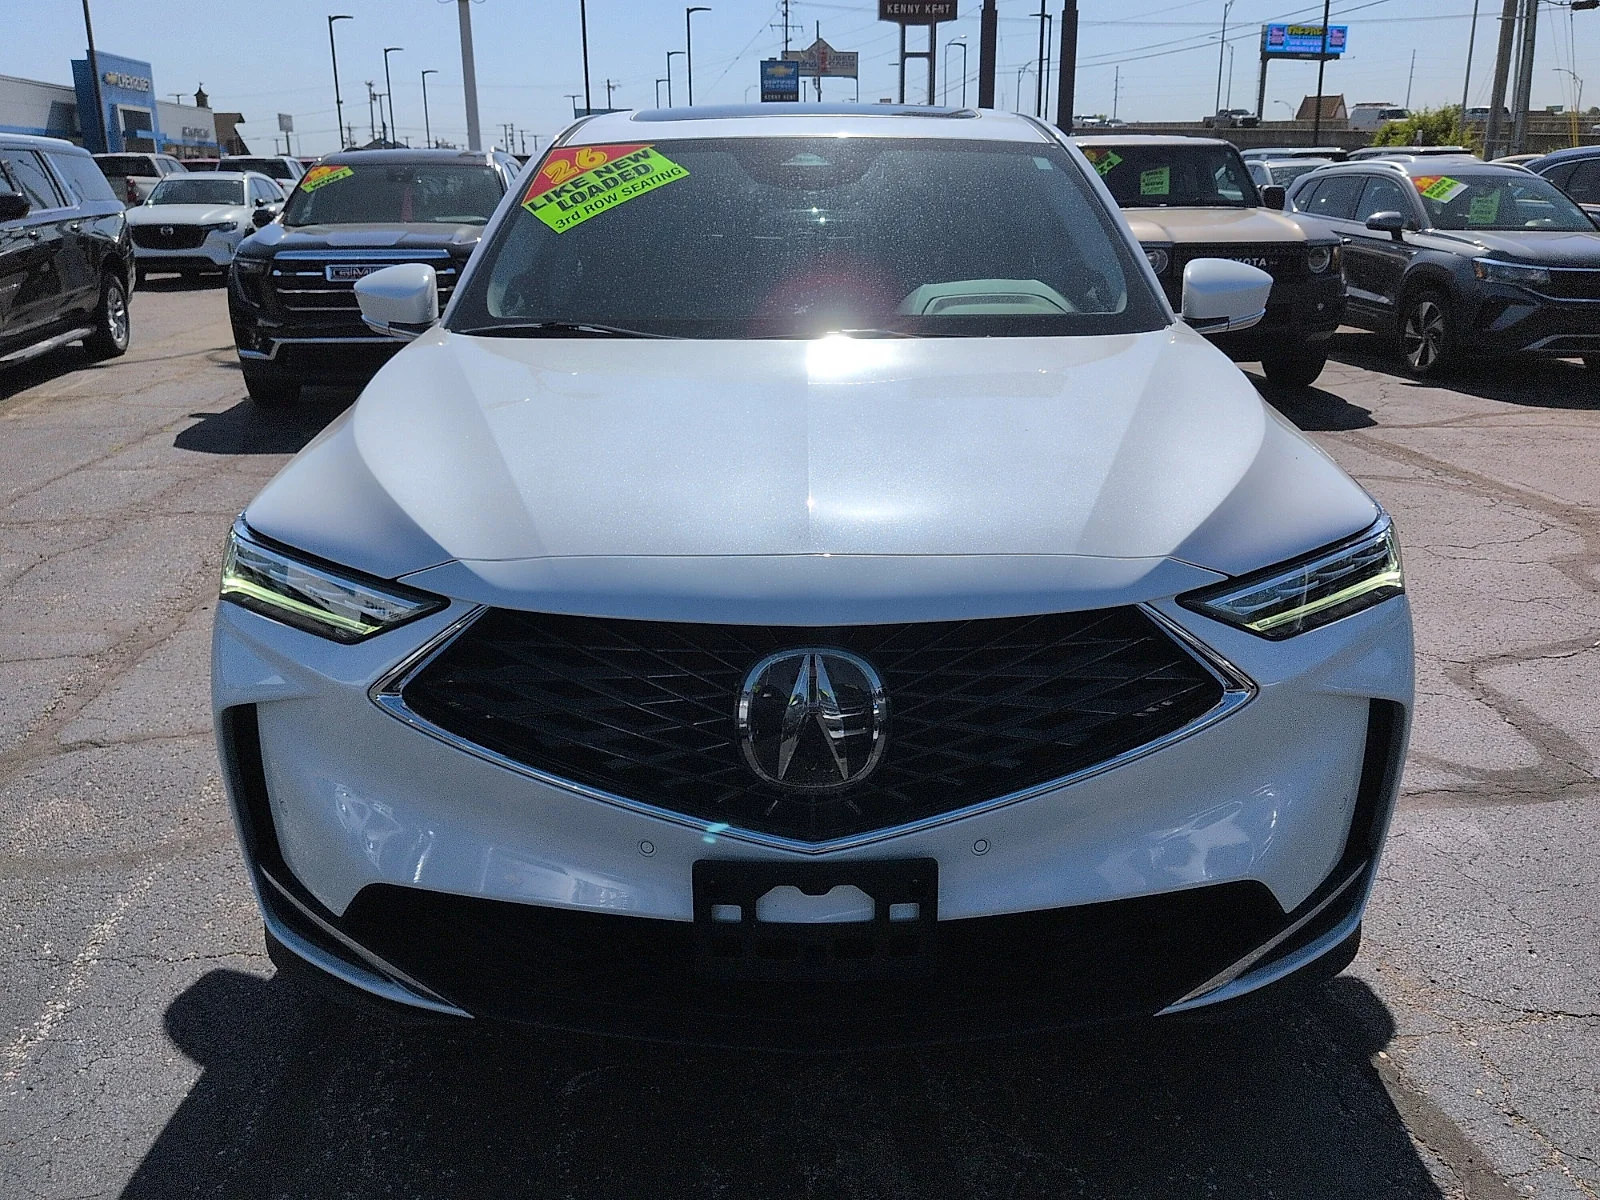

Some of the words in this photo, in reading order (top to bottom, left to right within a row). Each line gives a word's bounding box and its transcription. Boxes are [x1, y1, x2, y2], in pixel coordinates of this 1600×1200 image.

[887, 4, 920, 14] KENNY
[925, 4, 950, 14] KENT
[528, 176, 590, 211] LIKE
[592, 150, 653, 179] NEW
[543, 147, 607, 185] 26
[557, 163, 654, 211] LOADED
[556, 211, 581, 229] 3rd
[585, 193, 618, 215] ROW
[622, 167, 682, 197] SEATING
